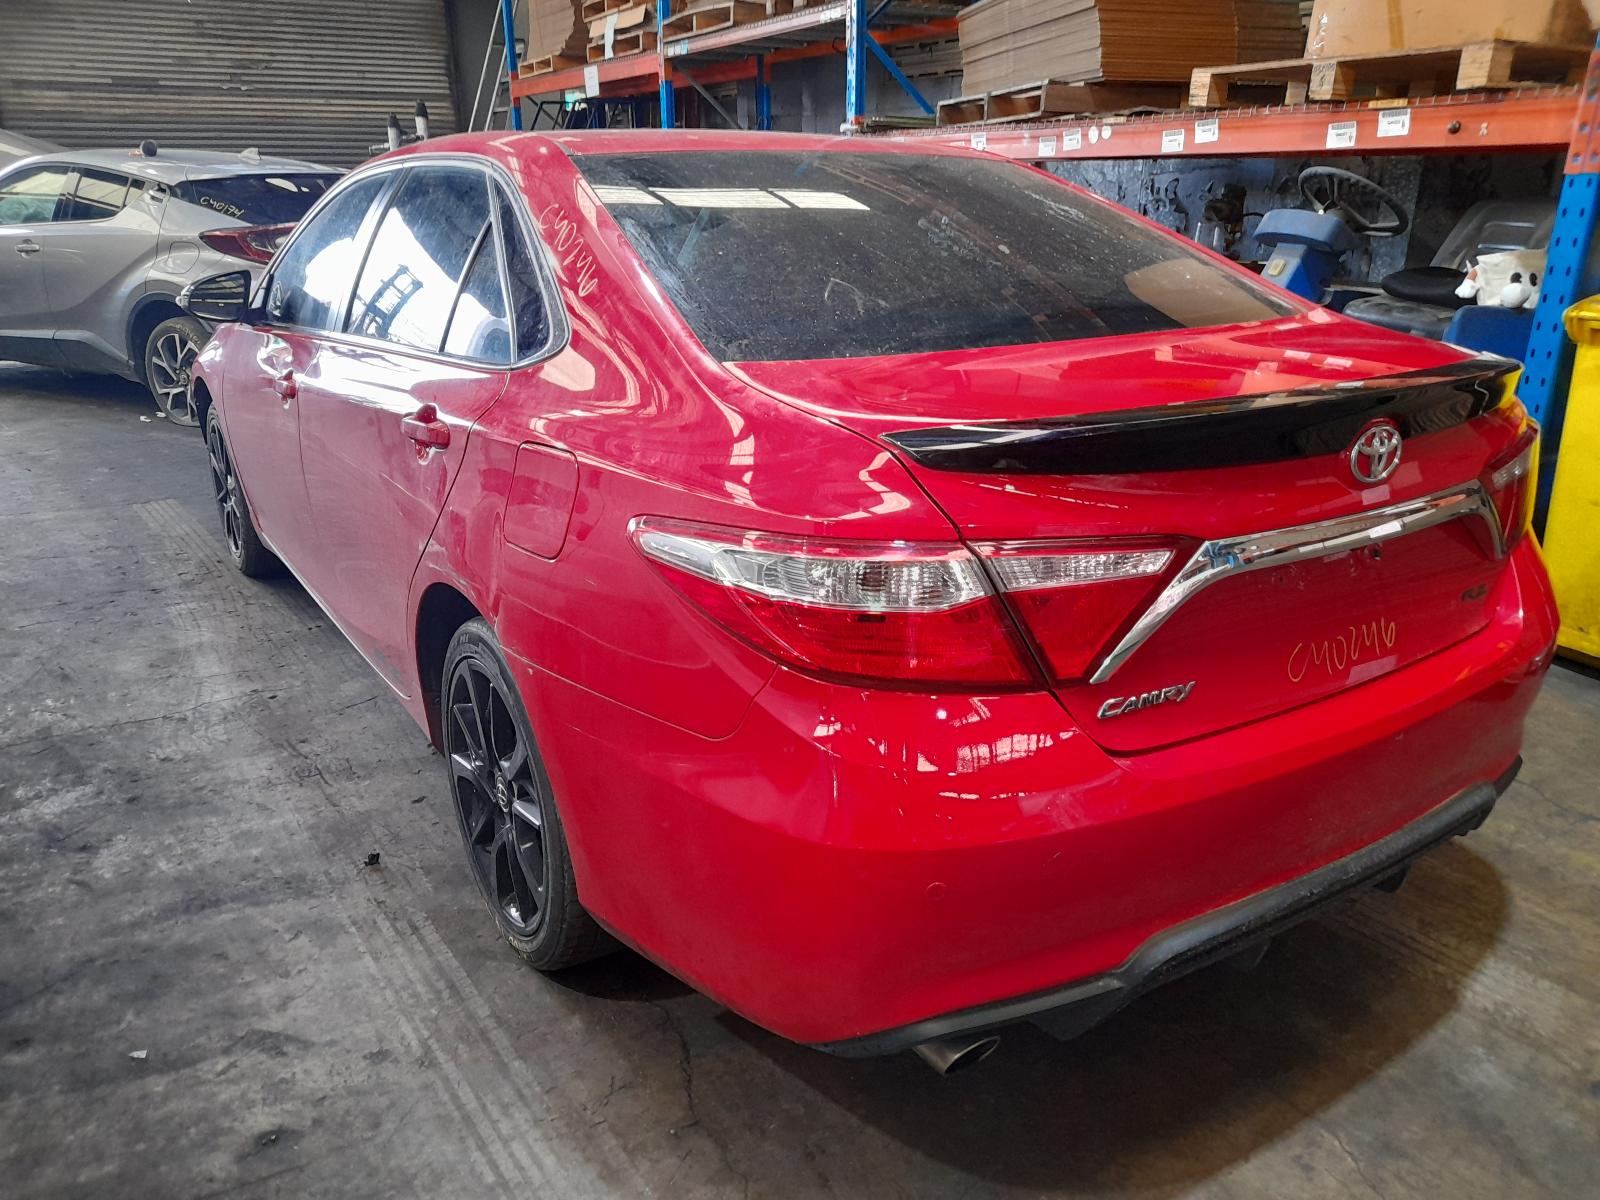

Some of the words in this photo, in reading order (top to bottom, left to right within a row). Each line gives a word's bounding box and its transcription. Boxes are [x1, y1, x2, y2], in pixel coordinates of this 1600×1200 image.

[200, 196, 245, 218] C40174
[1287, 616, 1396, 682] C40246
[1097, 681, 1196, 719] CAMRY
